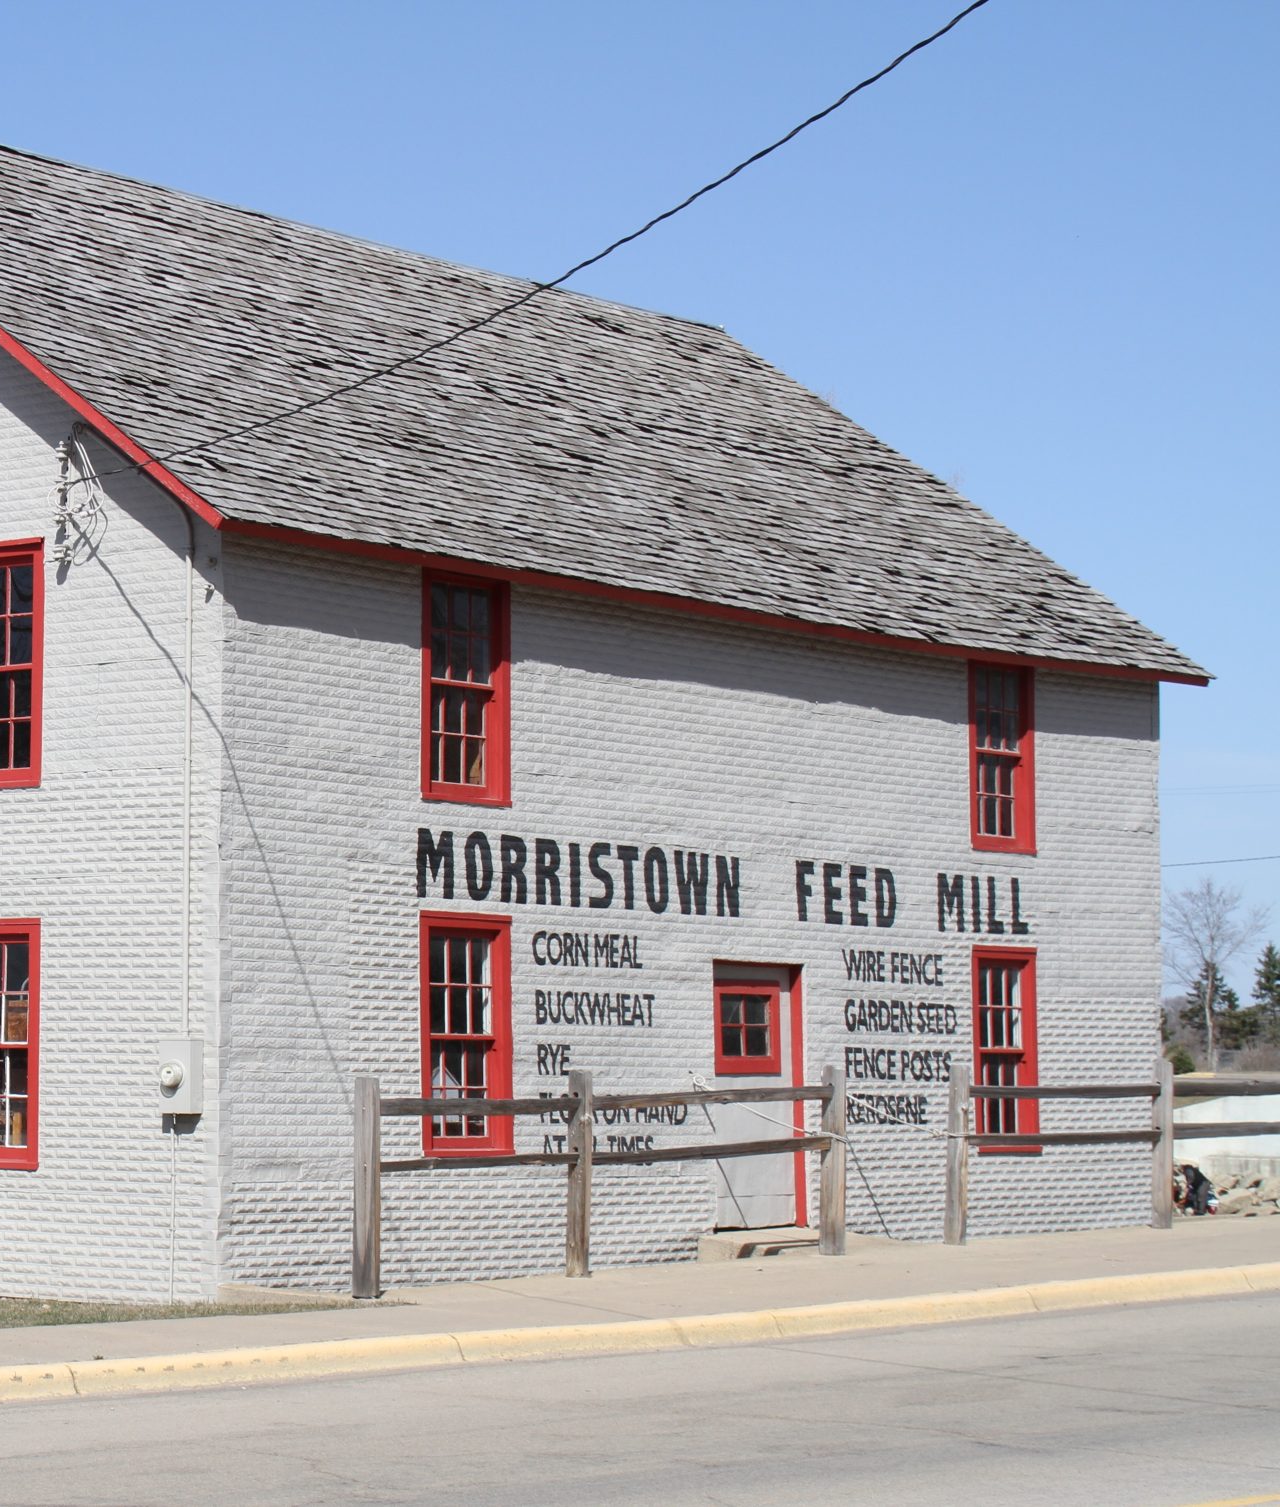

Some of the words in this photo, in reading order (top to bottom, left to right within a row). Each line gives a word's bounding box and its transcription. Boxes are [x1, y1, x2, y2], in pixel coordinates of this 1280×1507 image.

[416, 827, 740, 917] MORRISTOWN
[796, 860, 896, 928] FEED
[937, 872, 1029, 934] MILL
[532, 930, 589, 967] CORN
[594, 933, 643, 969] MEAL
[842, 949, 886, 982] WIRE
[890, 952, 943, 986] FENCE
[535, 989, 655, 1027] BUCKWHEAT
[844, 999, 913, 1033] GARDEN
[916, 1002, 957, 1035] SEED
[537, 1043, 571, 1076] RYE
[845, 1047, 896, 1080] FENCE
[901, 1050, 952, 1082] POSTS
[846, 1093, 928, 1125] KEROSENE
